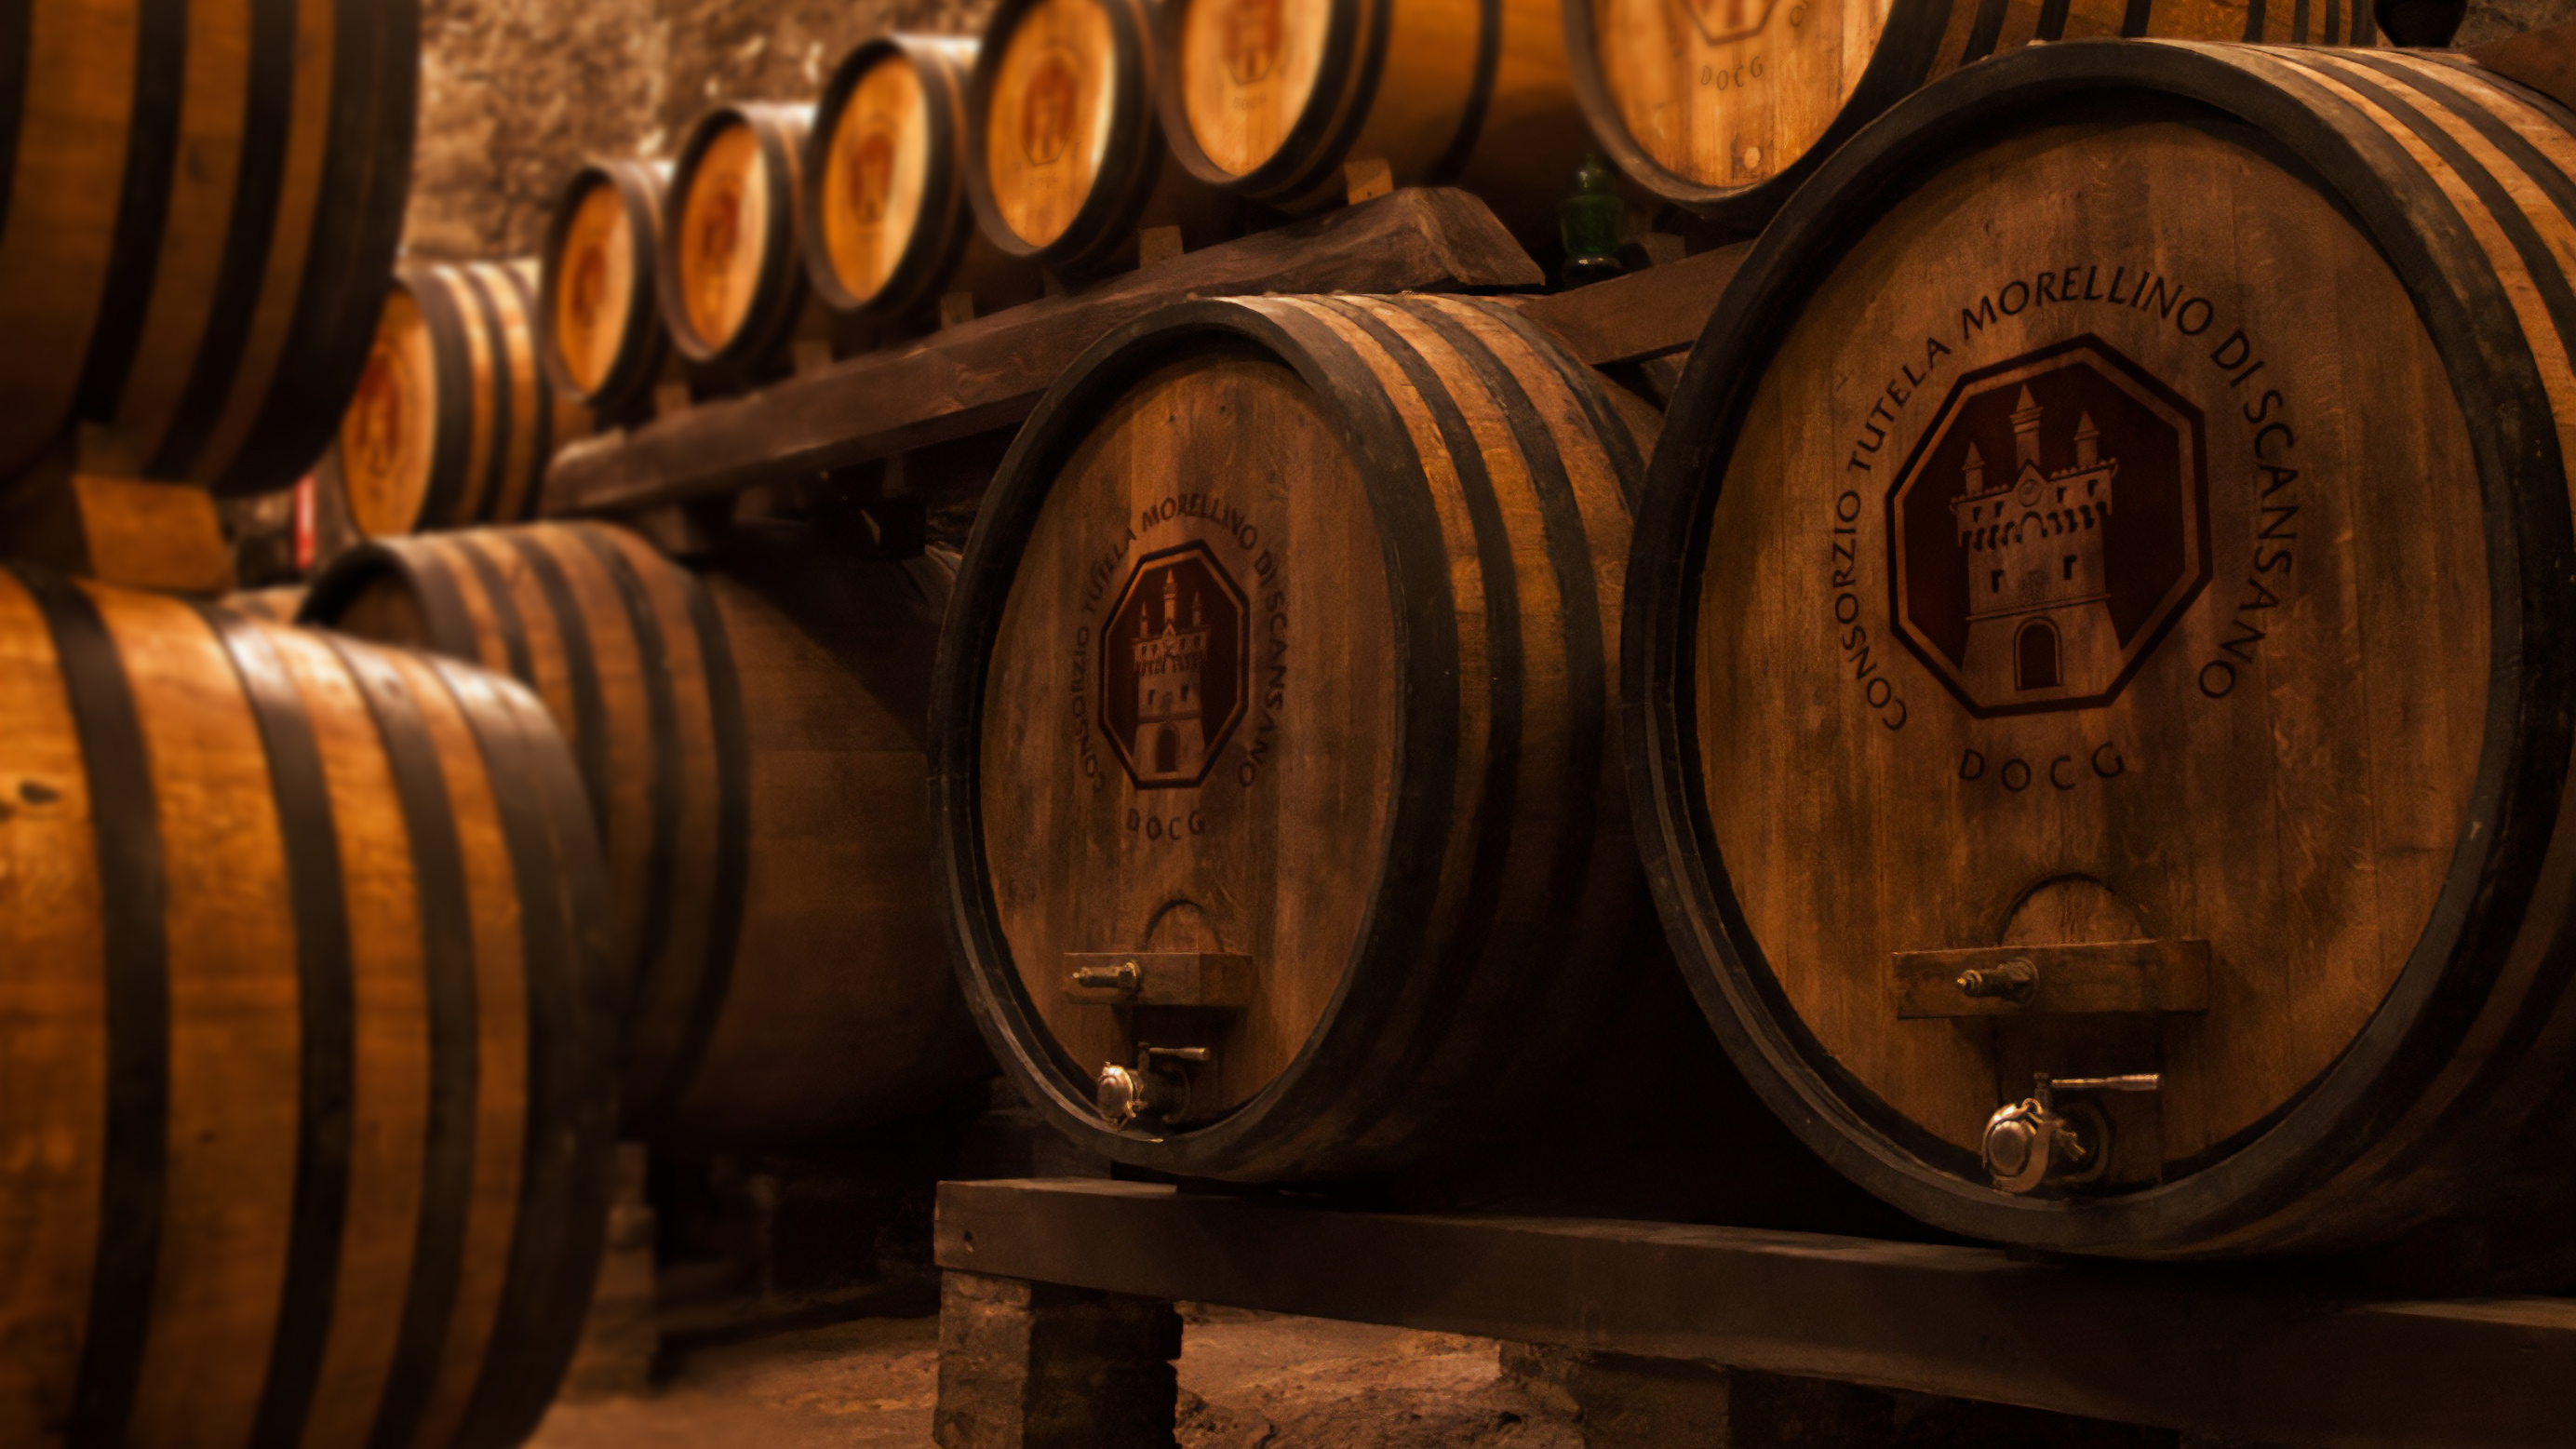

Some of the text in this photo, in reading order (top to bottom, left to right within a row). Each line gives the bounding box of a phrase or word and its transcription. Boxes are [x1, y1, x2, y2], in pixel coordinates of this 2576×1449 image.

[1700, 56, 1764, 91] DOCG
[1142, 492, 1258, 551] MORELLINO
[1832, 264, 2303, 731] CONSORZIO TUTELA MORELLINO DI SCANSANO
[1254, 549, 1280, 588] DI
[1238, 590, 1289, 787] SCANSANO
[1958, 742, 2126, 792] DOCG
[1126, 808, 1206, 841] DOCG
